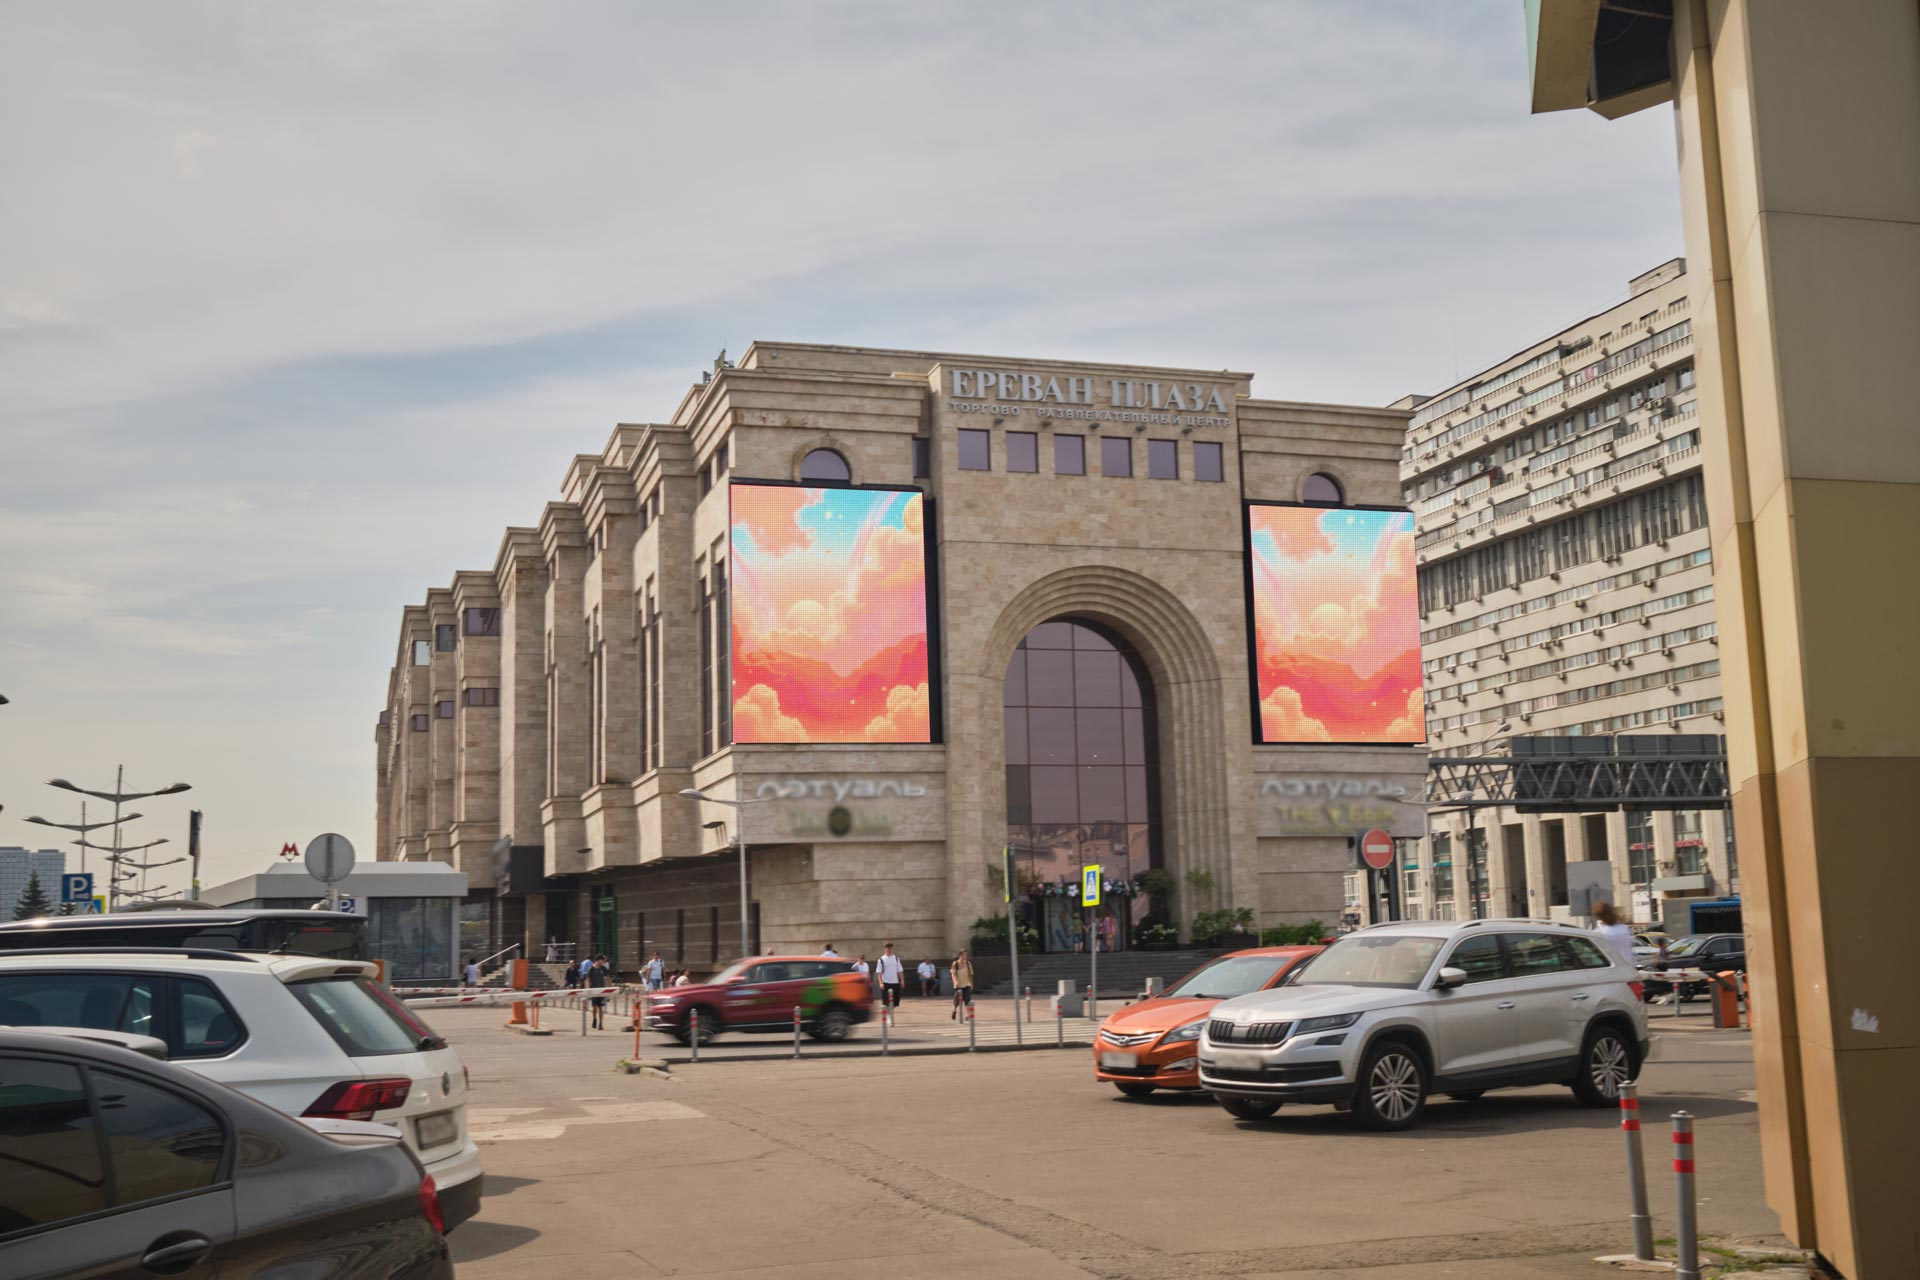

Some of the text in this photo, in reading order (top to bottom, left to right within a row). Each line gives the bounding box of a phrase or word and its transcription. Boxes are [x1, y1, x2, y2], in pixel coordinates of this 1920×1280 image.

[952, 369, 1228, 413] ЕРЕВАН ПЛАЗА
[950, 402, 1020, 416] ТОРГОВО
[1187, 415, 1232, 426] ЦЕНТР
[69, 876, 88, 899] P
